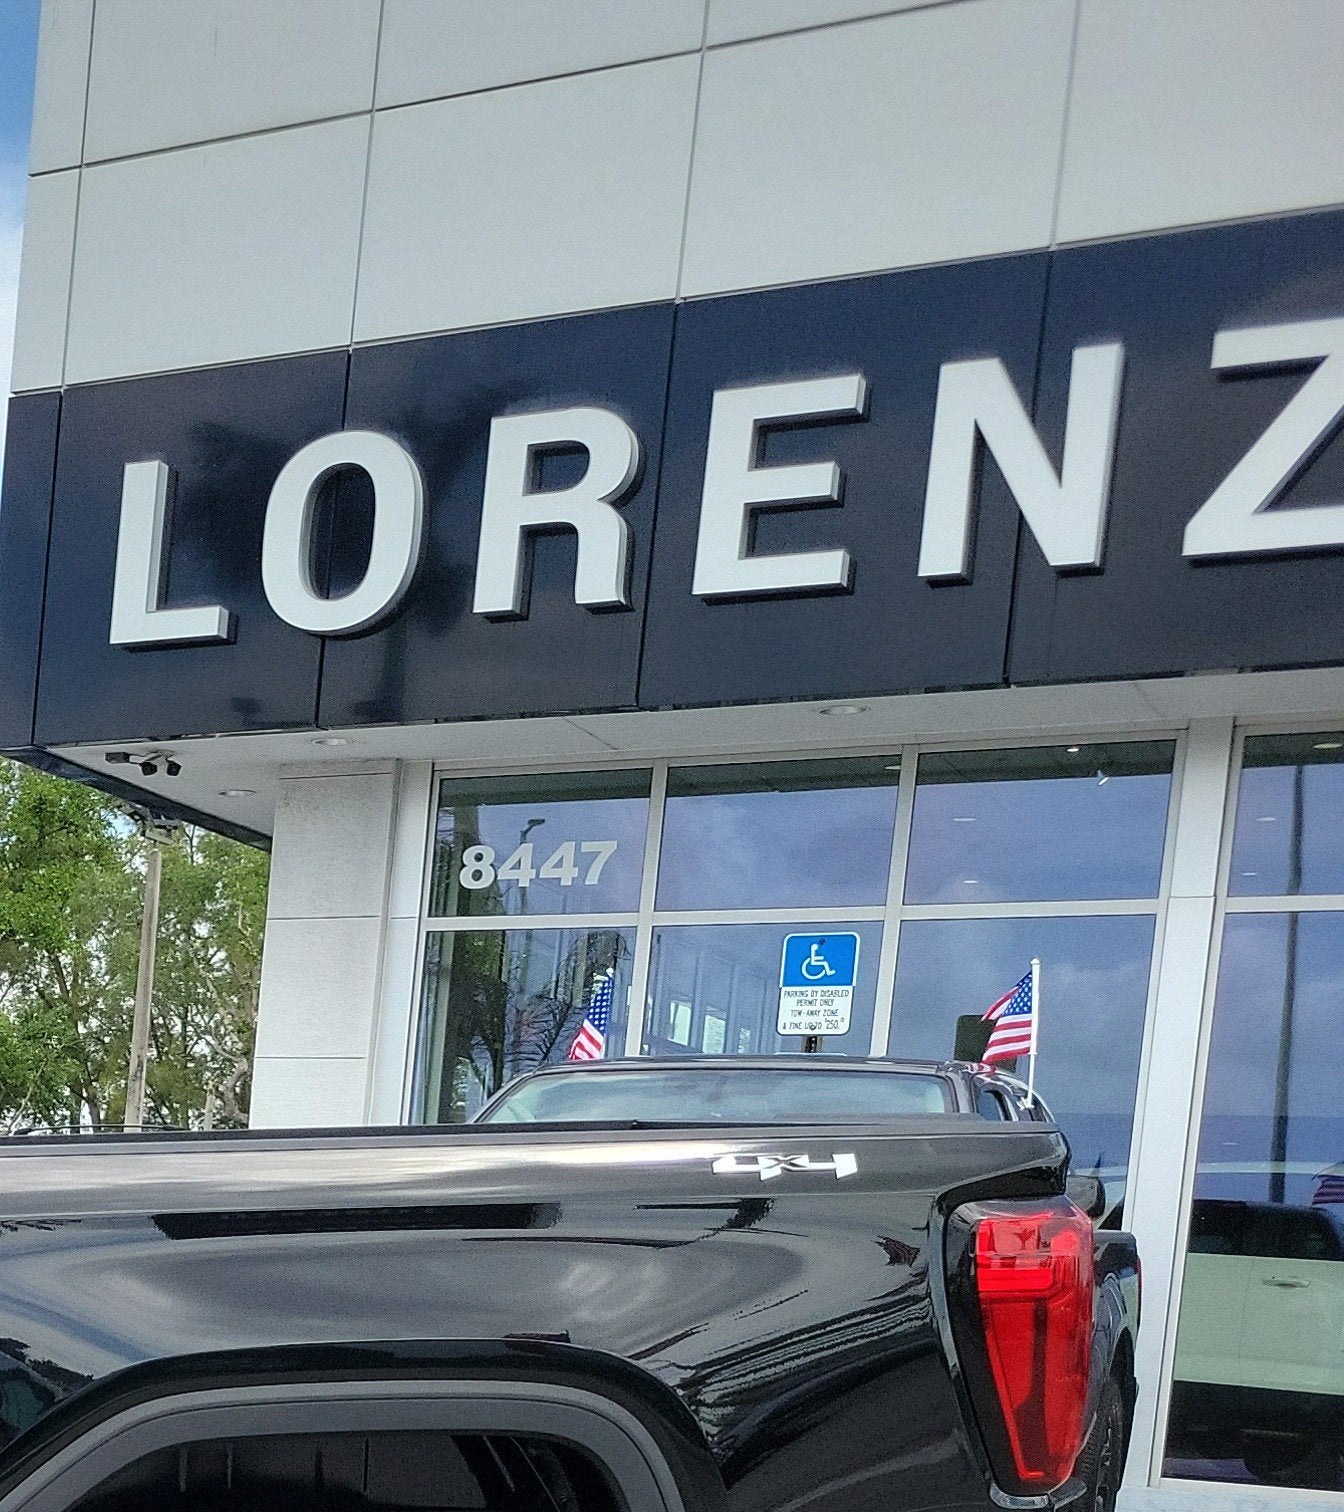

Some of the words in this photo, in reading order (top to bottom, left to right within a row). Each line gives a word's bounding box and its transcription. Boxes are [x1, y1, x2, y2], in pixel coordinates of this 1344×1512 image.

[109, 318, 1344, 647] LORENZ
[459, 840, 618, 890] 8447
[784, 990, 809, 998] PARKING
[810, 990, 819, 998] BY
[820, 989, 850, 998] DISABLED
[796, 999, 818, 1007] PERMIT
[823, 1009, 839, 1017] ZONE
[789, 1022, 803, 1030] FINE
